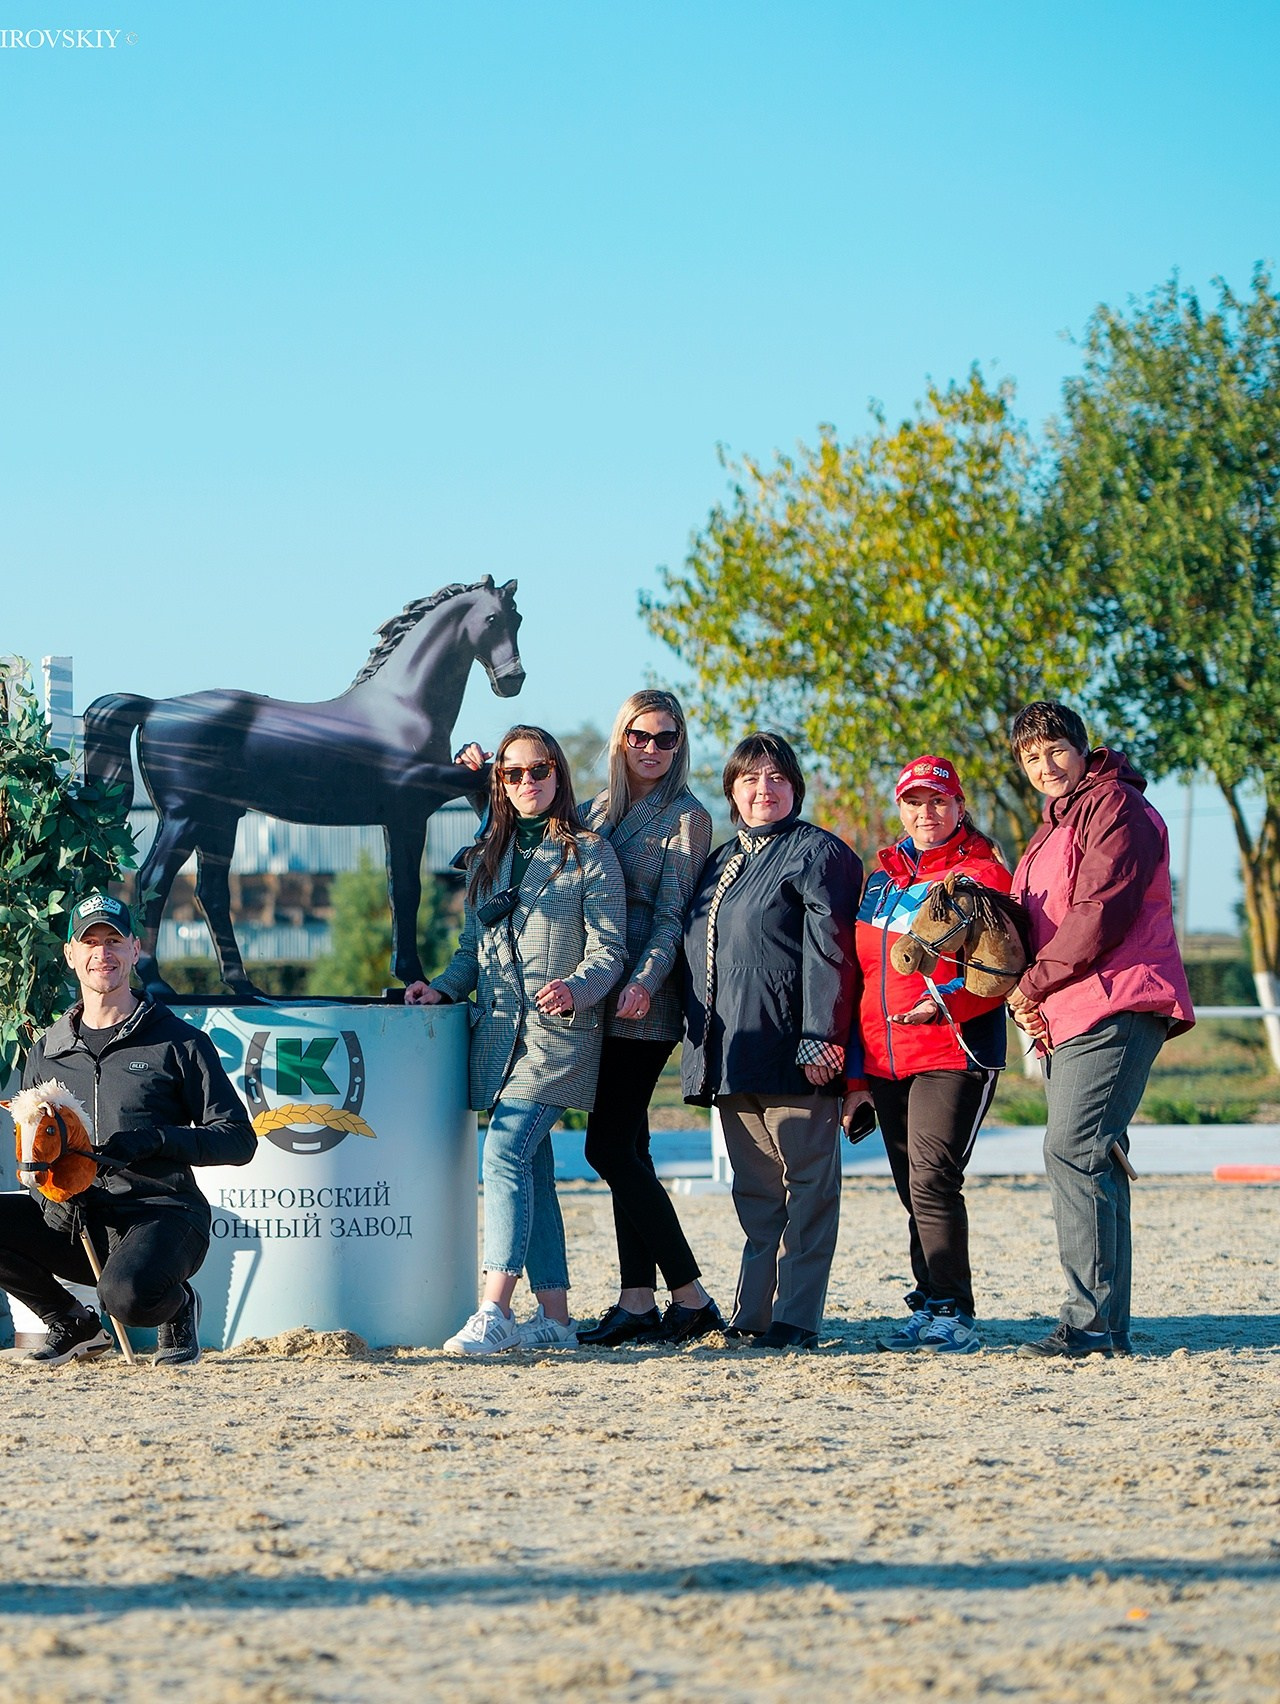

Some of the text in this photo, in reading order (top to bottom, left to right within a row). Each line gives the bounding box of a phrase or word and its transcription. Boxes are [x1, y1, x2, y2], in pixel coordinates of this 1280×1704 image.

[276, 1037, 341, 1095] К
[218, 1181, 391, 1208] КИРОВСКИЙ
[211, 1212, 413, 1240] ОННЫЙ ЗАВОД
